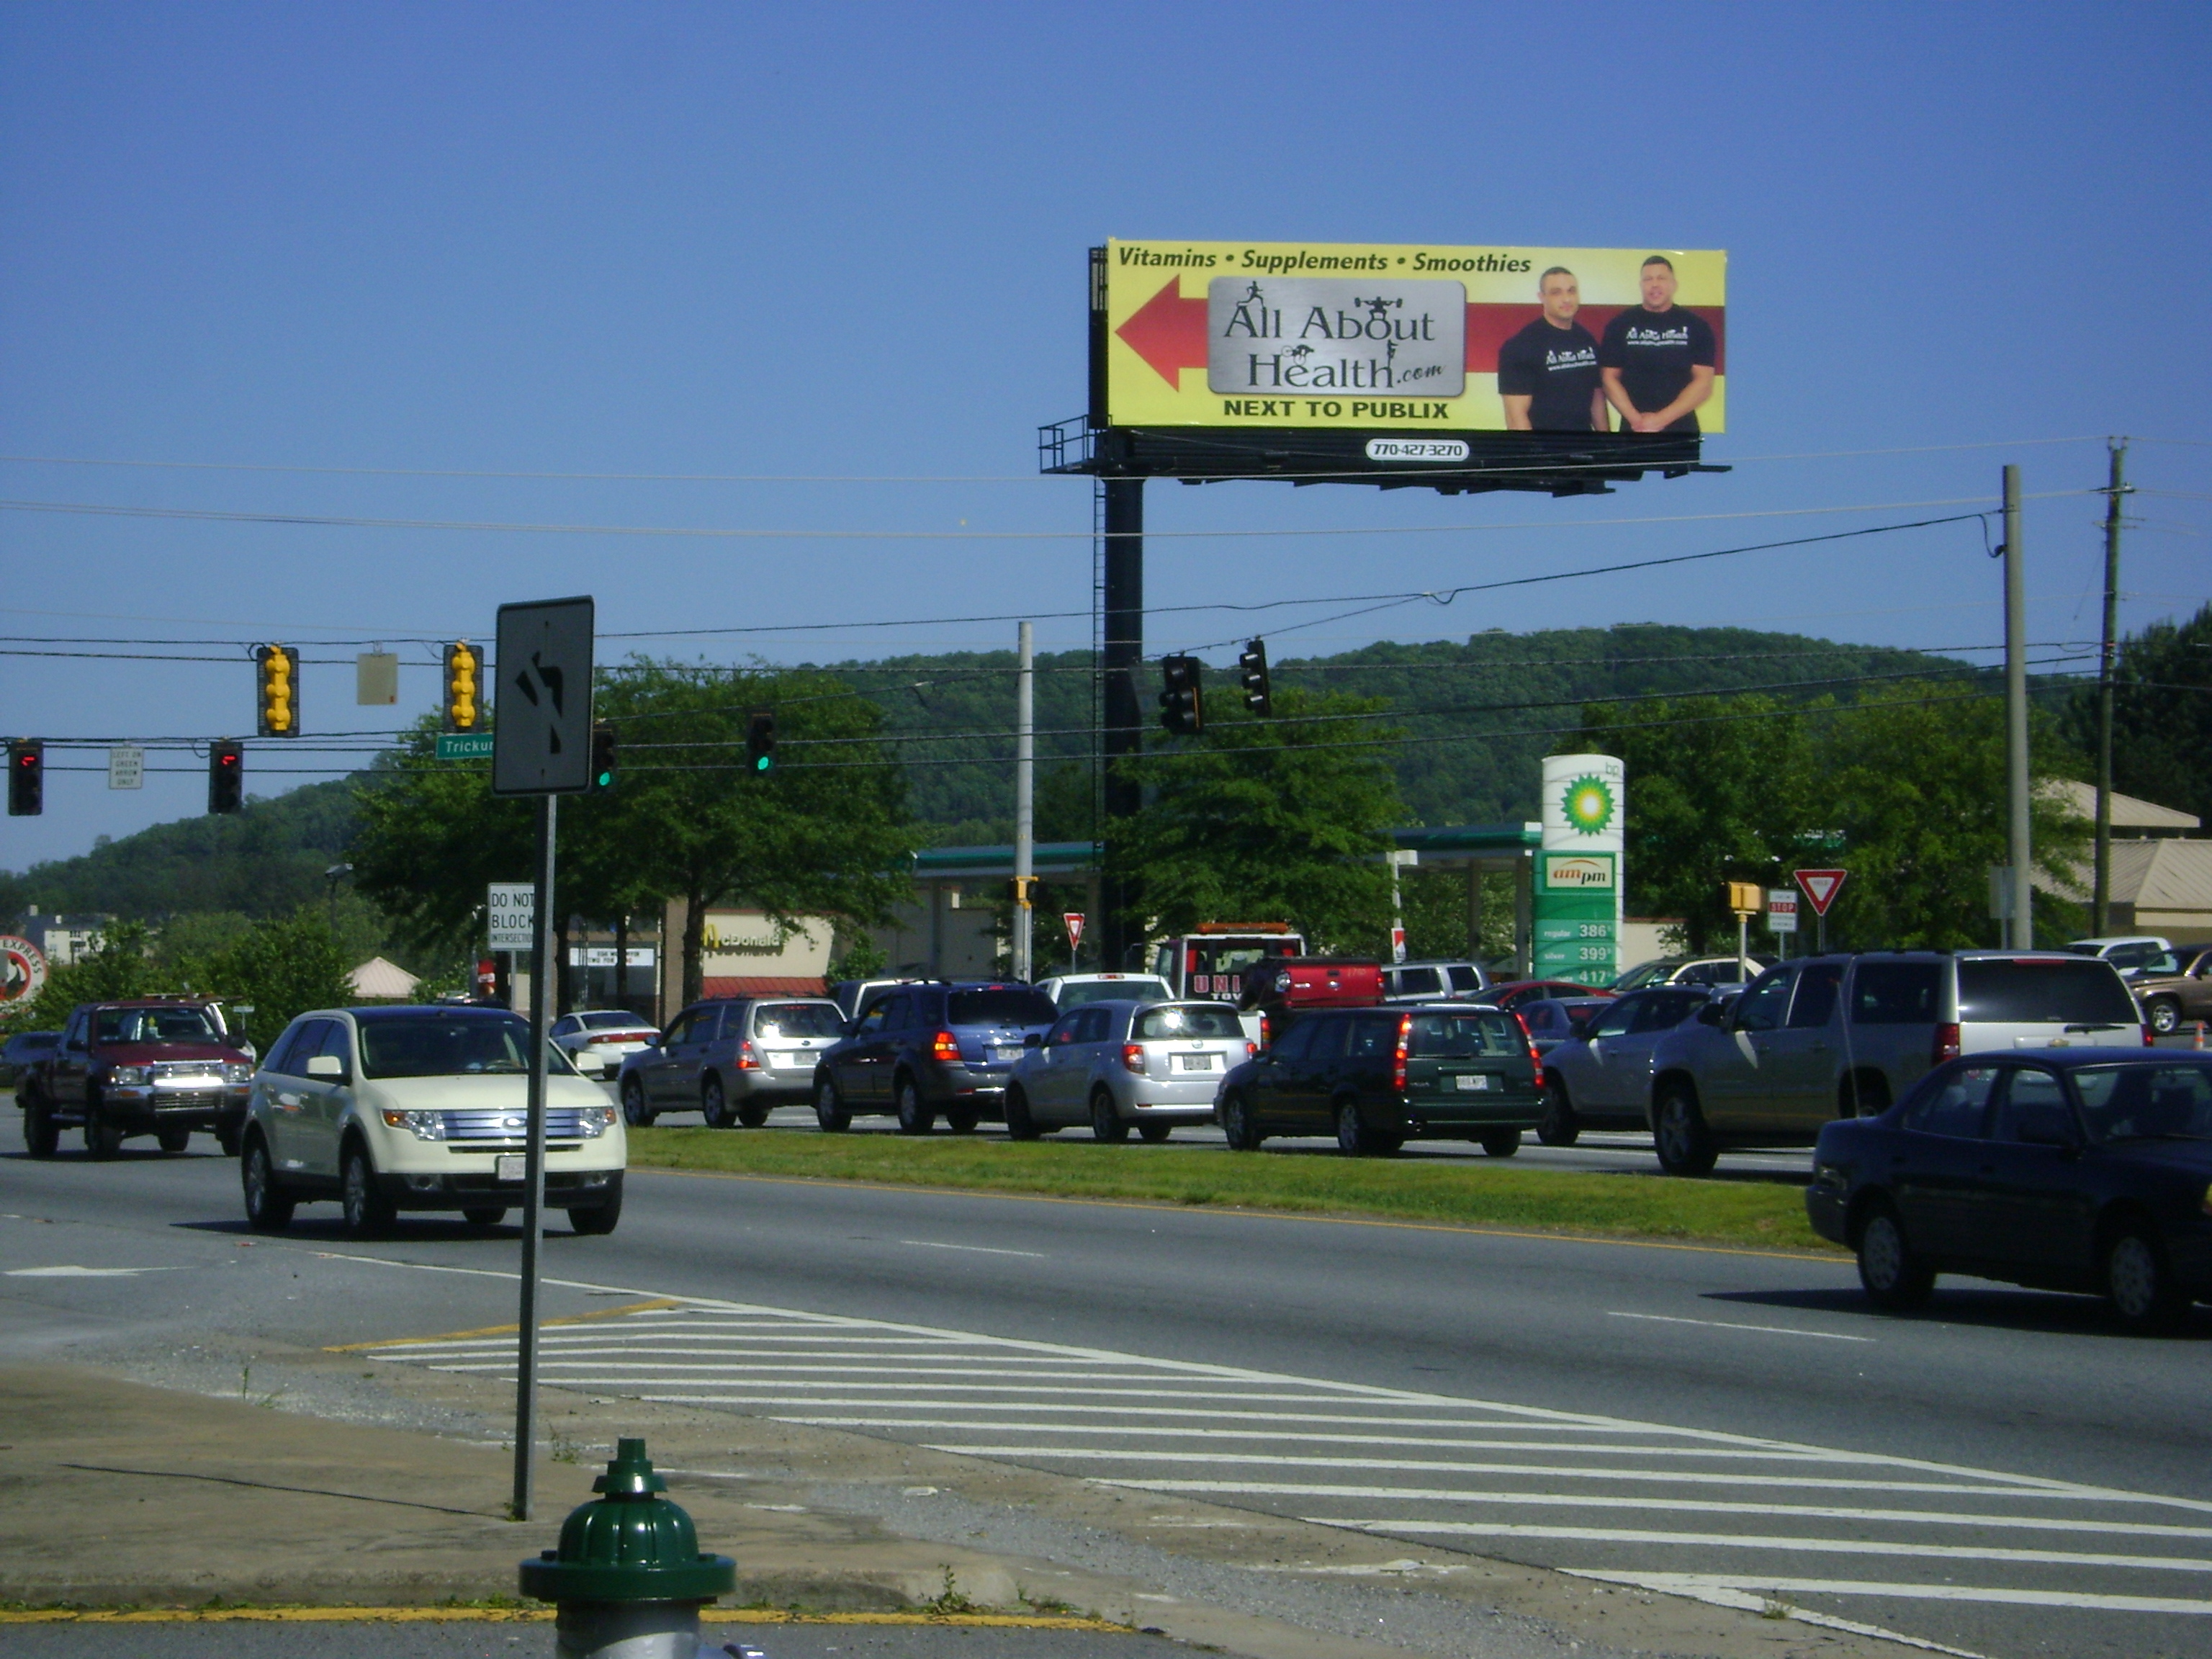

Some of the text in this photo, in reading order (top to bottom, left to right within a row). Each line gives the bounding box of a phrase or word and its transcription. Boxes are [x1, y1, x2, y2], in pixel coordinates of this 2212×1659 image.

[1120, 247, 1532, 274] Vitamins Supplements Smoothies
[1224, 305, 1435, 341] All About
[1224, 400, 1449, 419] NEXT TO PUBLIX
[1374, 444, 1462, 457] 770-427-3270
[1606, 762, 1619, 777] bp
[491, 893, 508, 907] DO
[1771, 903, 1795, 912] STOP
[491, 914, 533, 929] BLOCK
[491, 934, 533, 943] INTERSECTIO
[2, 939, 42, 974] EXPRESS
